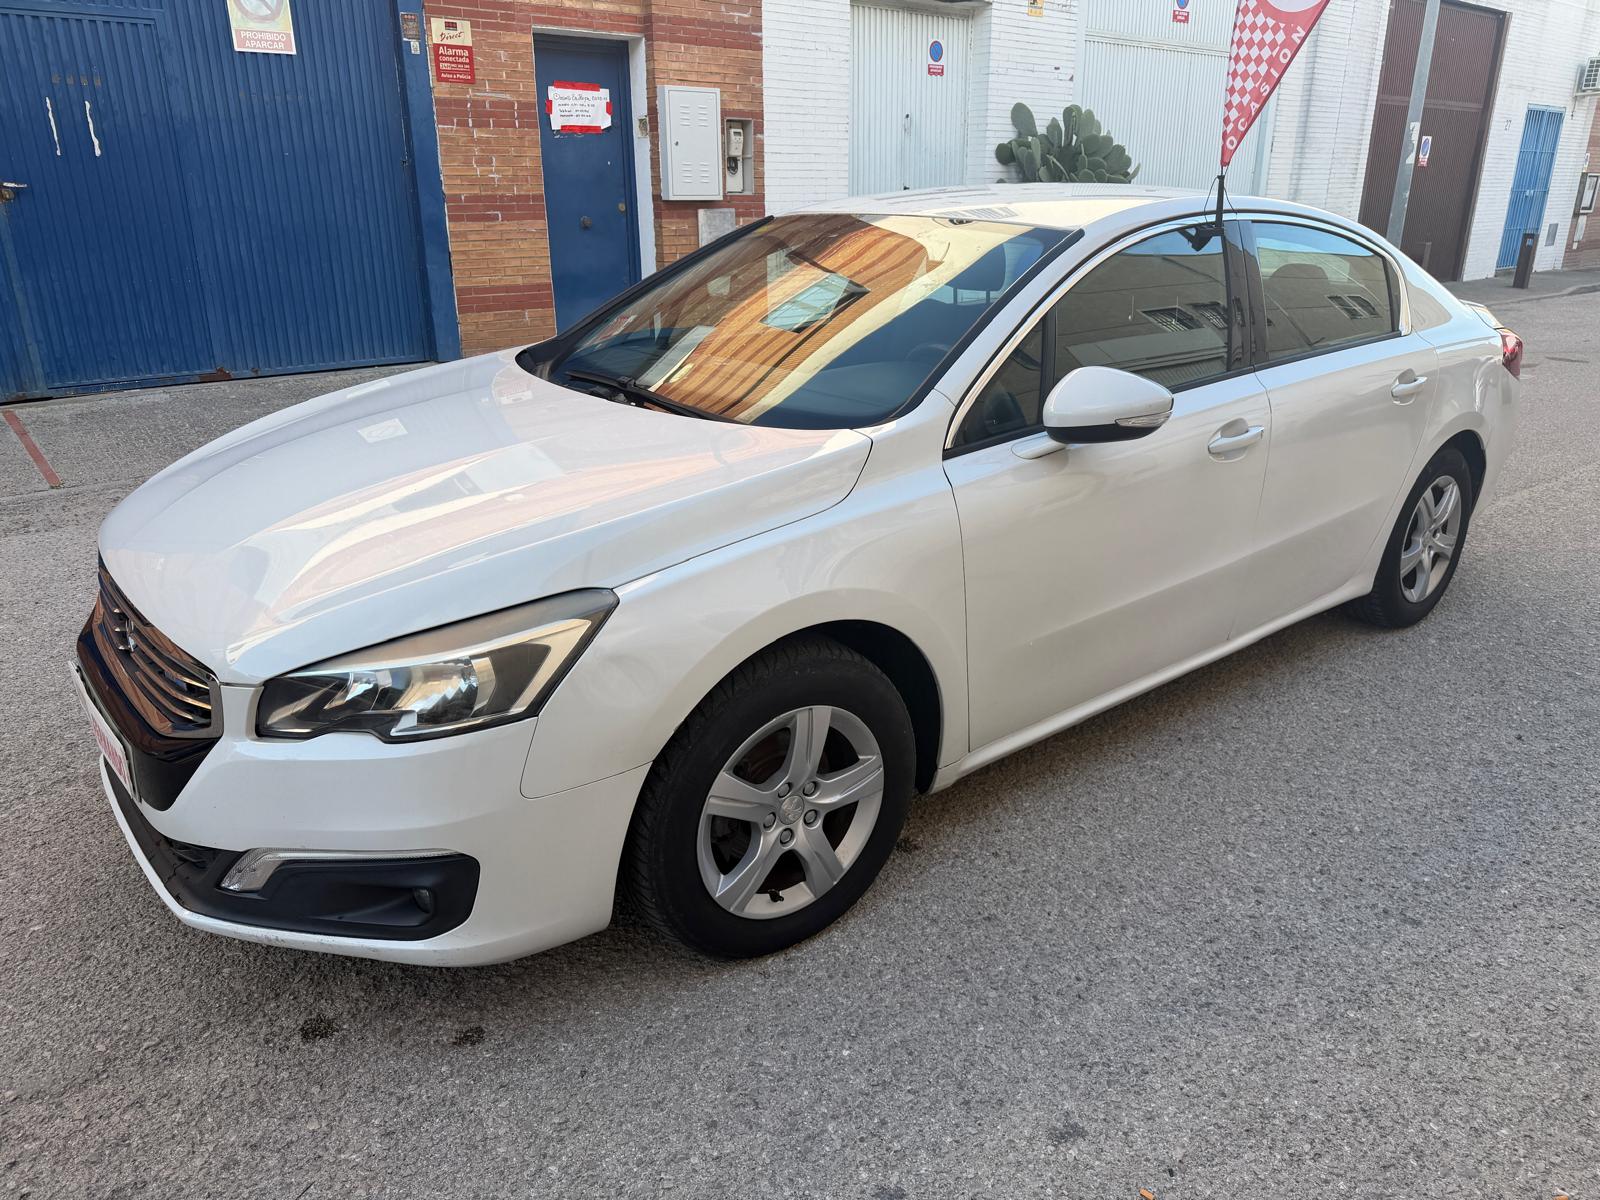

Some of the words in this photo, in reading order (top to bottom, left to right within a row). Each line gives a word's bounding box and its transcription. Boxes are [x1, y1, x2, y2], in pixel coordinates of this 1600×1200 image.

[240, 31, 286, 41] PROHIBIDO
[245, 40, 284, 49] APARCAR
[438, 46, 469, 56] Alarma
[439, 55, 469, 63] conectada
[1226, 25, 1305, 150] OCASION
[1504, 119, 1512, 131] 27
